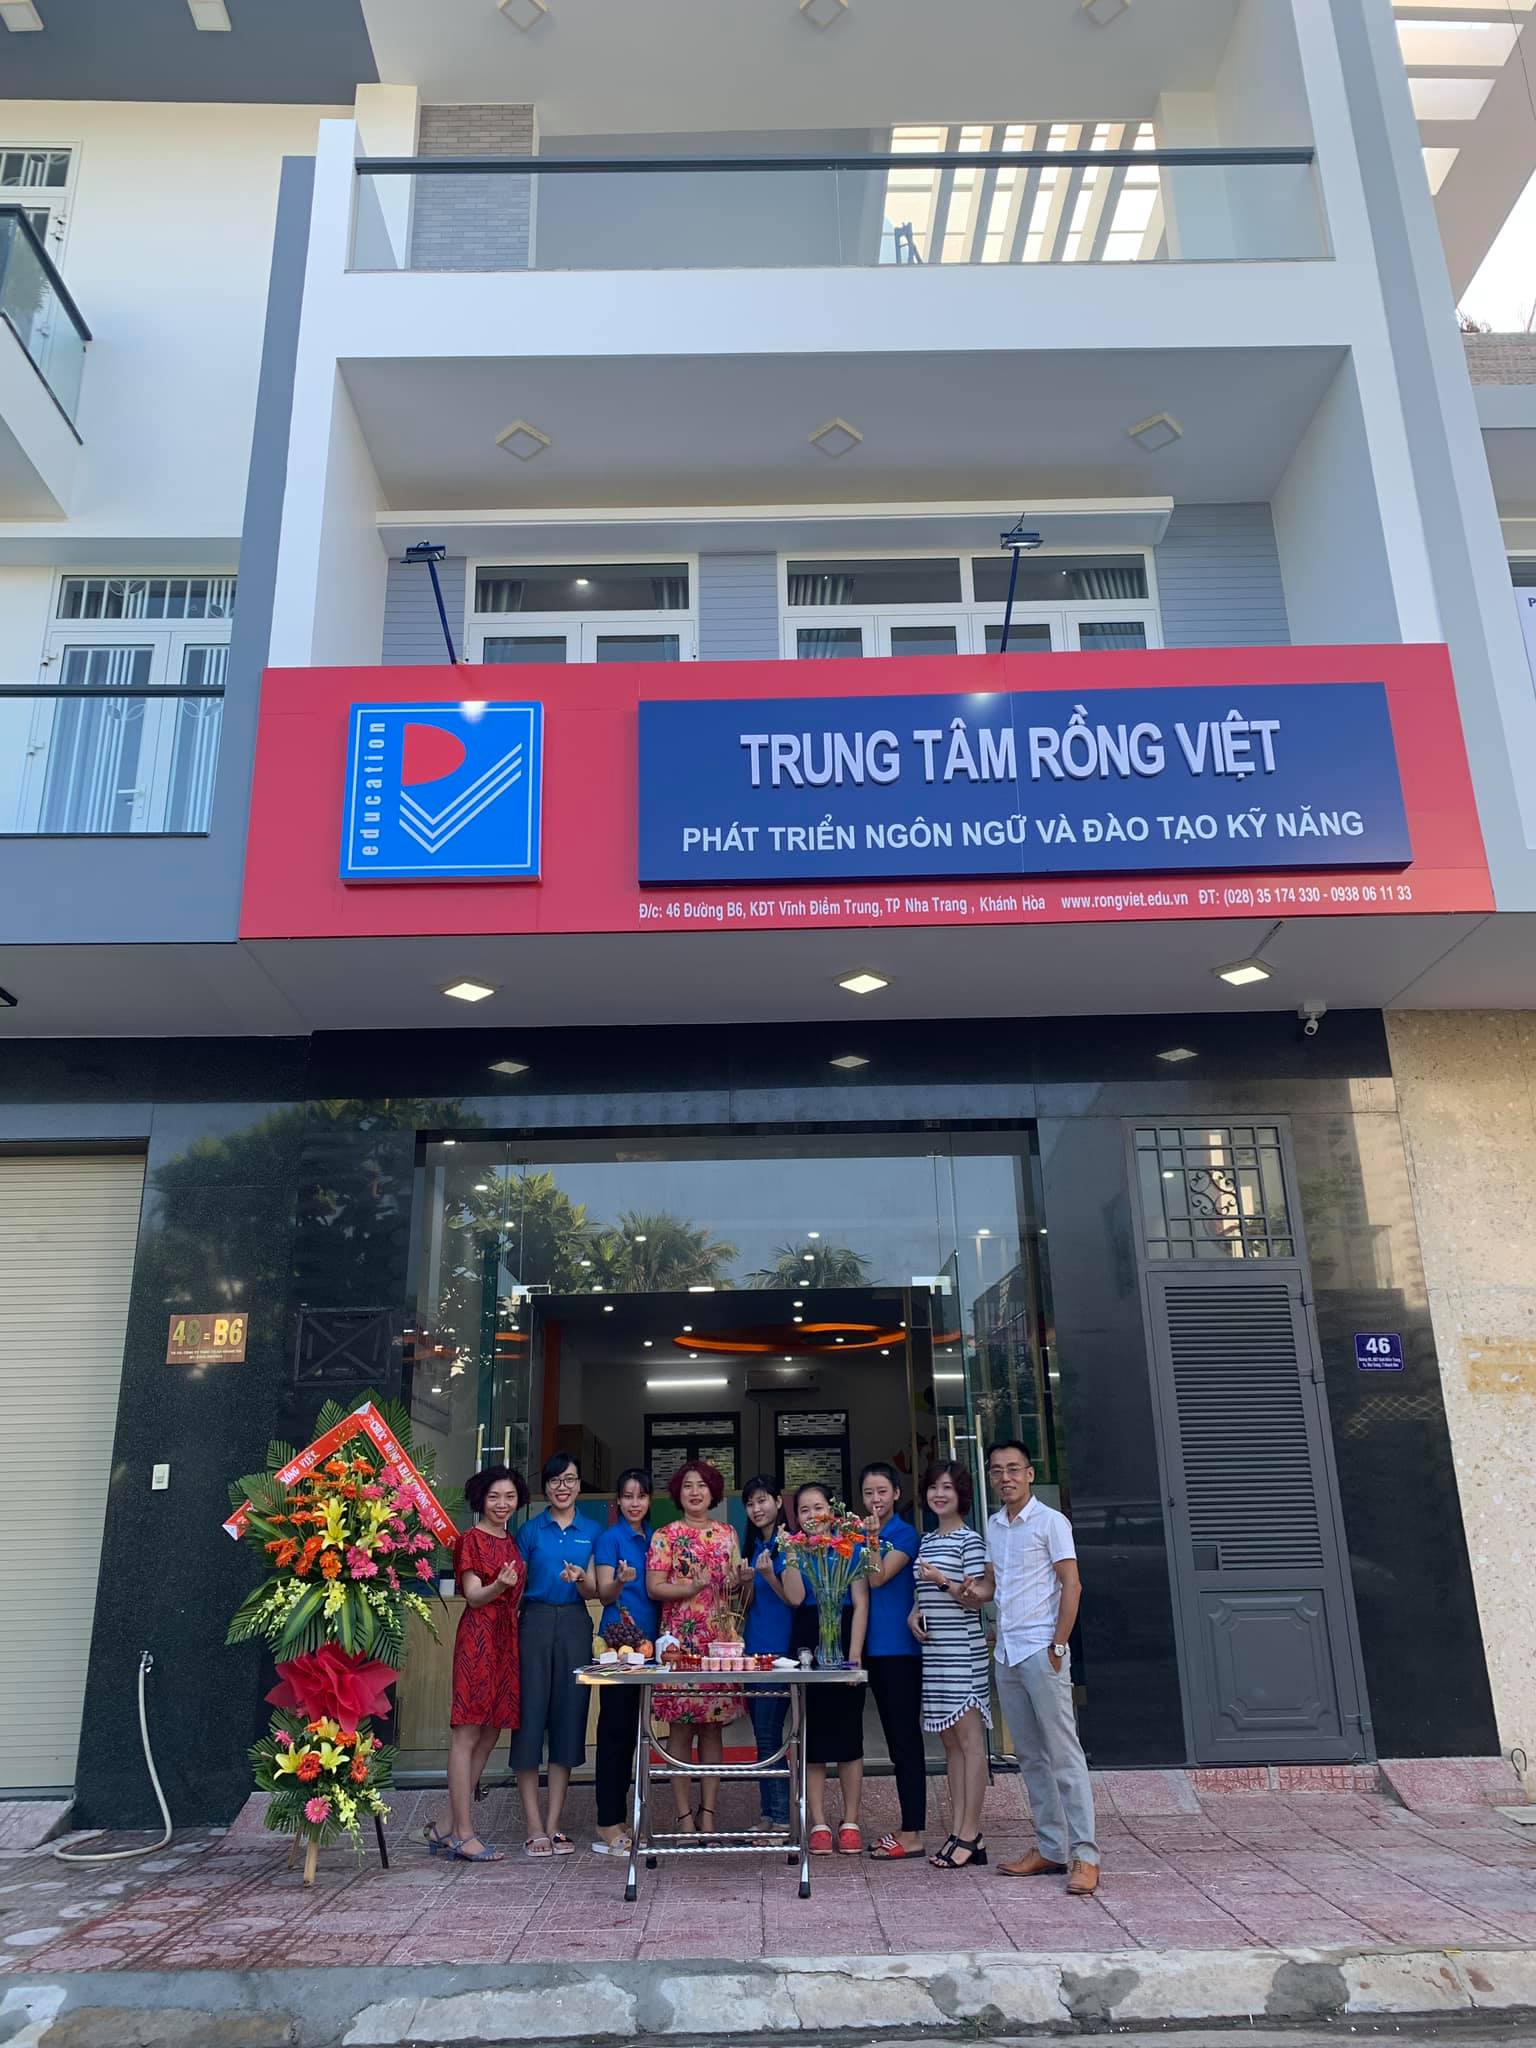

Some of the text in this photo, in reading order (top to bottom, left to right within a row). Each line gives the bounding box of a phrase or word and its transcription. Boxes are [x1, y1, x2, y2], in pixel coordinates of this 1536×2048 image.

[740, 703, 1281, 787] TRUNG TÂM RỒNG VIỆT
[359, 722, 386, 857] education
[683, 805, 1365, 852] PHÁT TRIỂN NGÔN NGỮ VÀ ĐÀO TẠO KỸ NĂNG
[639, 903, 662, 920] Đ/c:
[666, 903, 681, 918] 46
[683, 902, 724, 921] Đường
[727, 902, 747, 920] B6,
[750, 901, 775, 917] KĐT
[778, 899, 806, 916] Vĩnh
[809, 896, 841, 915] Điềm
[843, 898, 883, 918] Trung,
[884, 898, 901, 913] TP
[905, 897, 929, 913] Nha
[931, 896, 968, 915] Trang
[979, 895, 1018, 912] Khánh
[1021, 894, 1046, 911] Hòa
[1061, 890, 1189, 911] www.rongviet.edu.vn
[1198, 889, 1221, 905] ĐT:
[1223, 888, 1255, 907] (028)
[1256, 888, 1272, 904] 35
[1274, 887, 1297, 903] 174
[1298, 887, 1321, 903] 330
[1330, 885, 1360, 902] 0938
[1362, 885, 1377, 901] 06
[1379, 885, 1394, 901] 11
[1396, 884, 1413, 901] 33
[1366, 1337, 1391, 1354] 46
